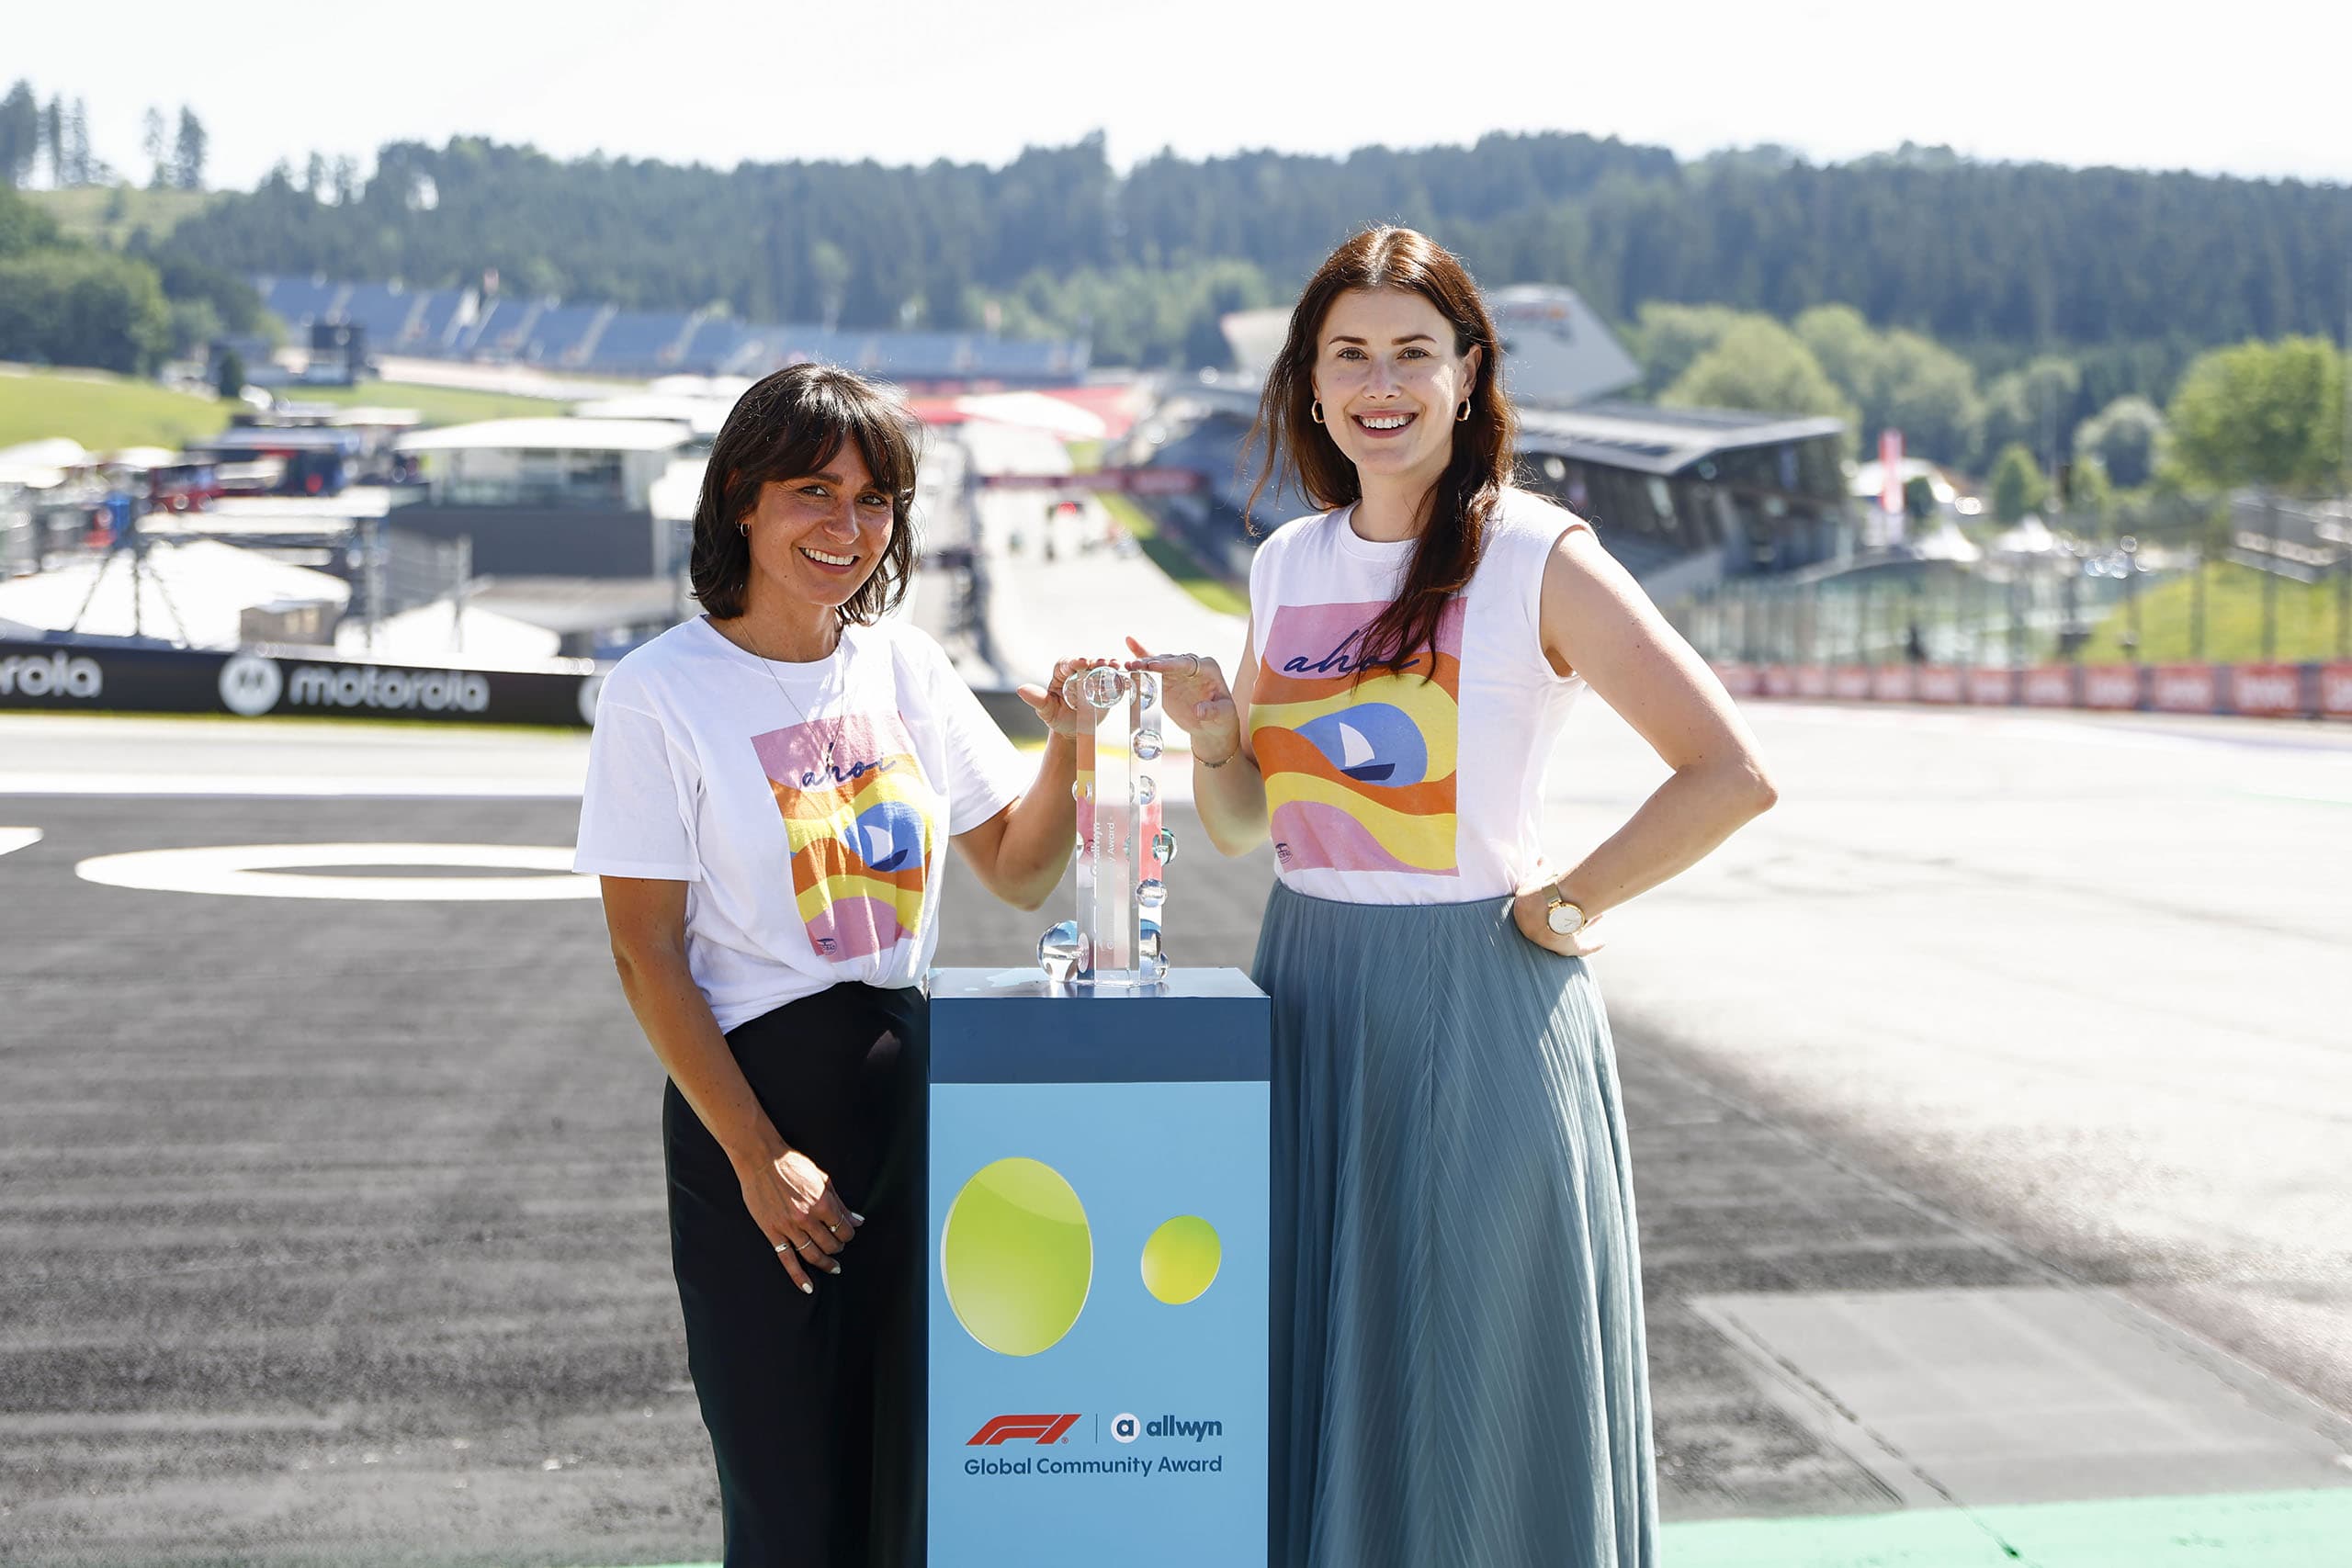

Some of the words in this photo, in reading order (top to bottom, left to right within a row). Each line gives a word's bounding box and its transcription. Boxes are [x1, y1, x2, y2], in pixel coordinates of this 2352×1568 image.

[1283, 629, 1420, 673] aho
[288, 665, 491, 712] motorola
[1146, 1415, 1223, 1442] allwyn
[964, 1458, 1032, 1475] Global
[1036, 1457, 1153, 1477] Community
[1158, 1455, 1223, 1473] Award
